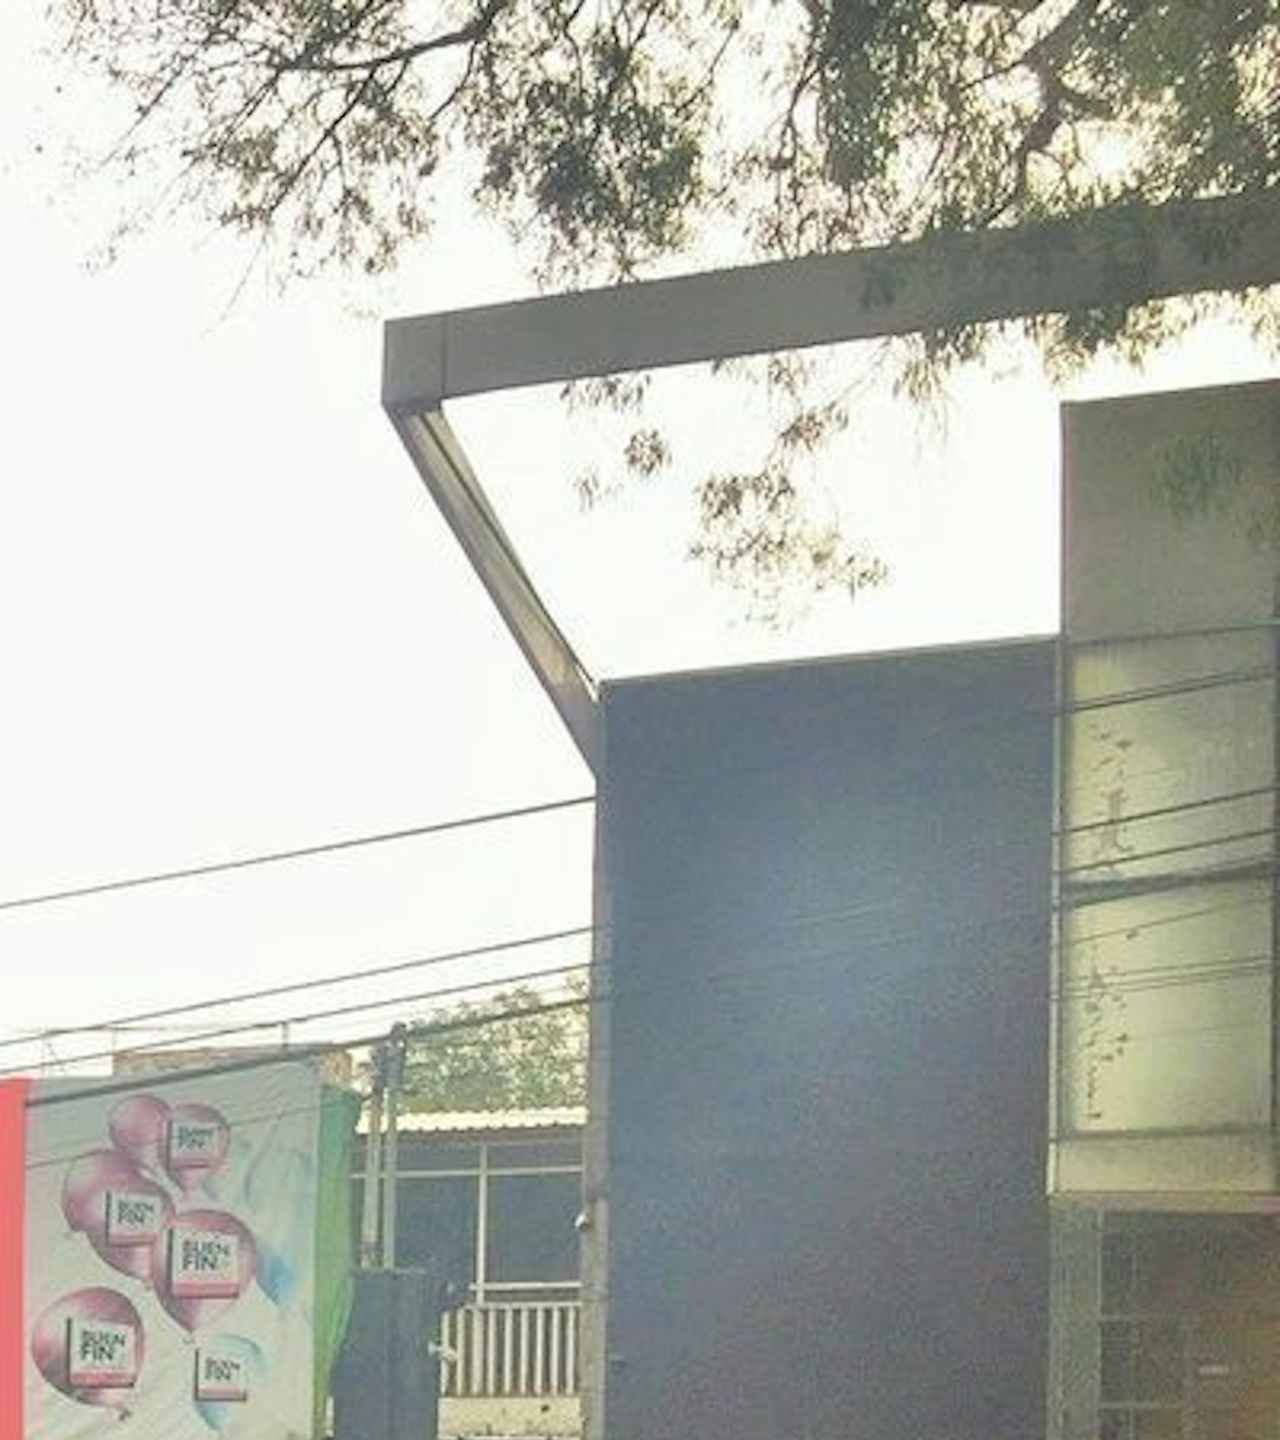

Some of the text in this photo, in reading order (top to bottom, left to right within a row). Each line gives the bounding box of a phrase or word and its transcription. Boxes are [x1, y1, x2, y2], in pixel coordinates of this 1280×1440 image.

[181, 1238, 230, 1257] BUEN
[181, 1253, 218, 1271] FIN
[81, 1328, 127, 1346] BUEN
[80, 1341, 114, 1361] FIN
